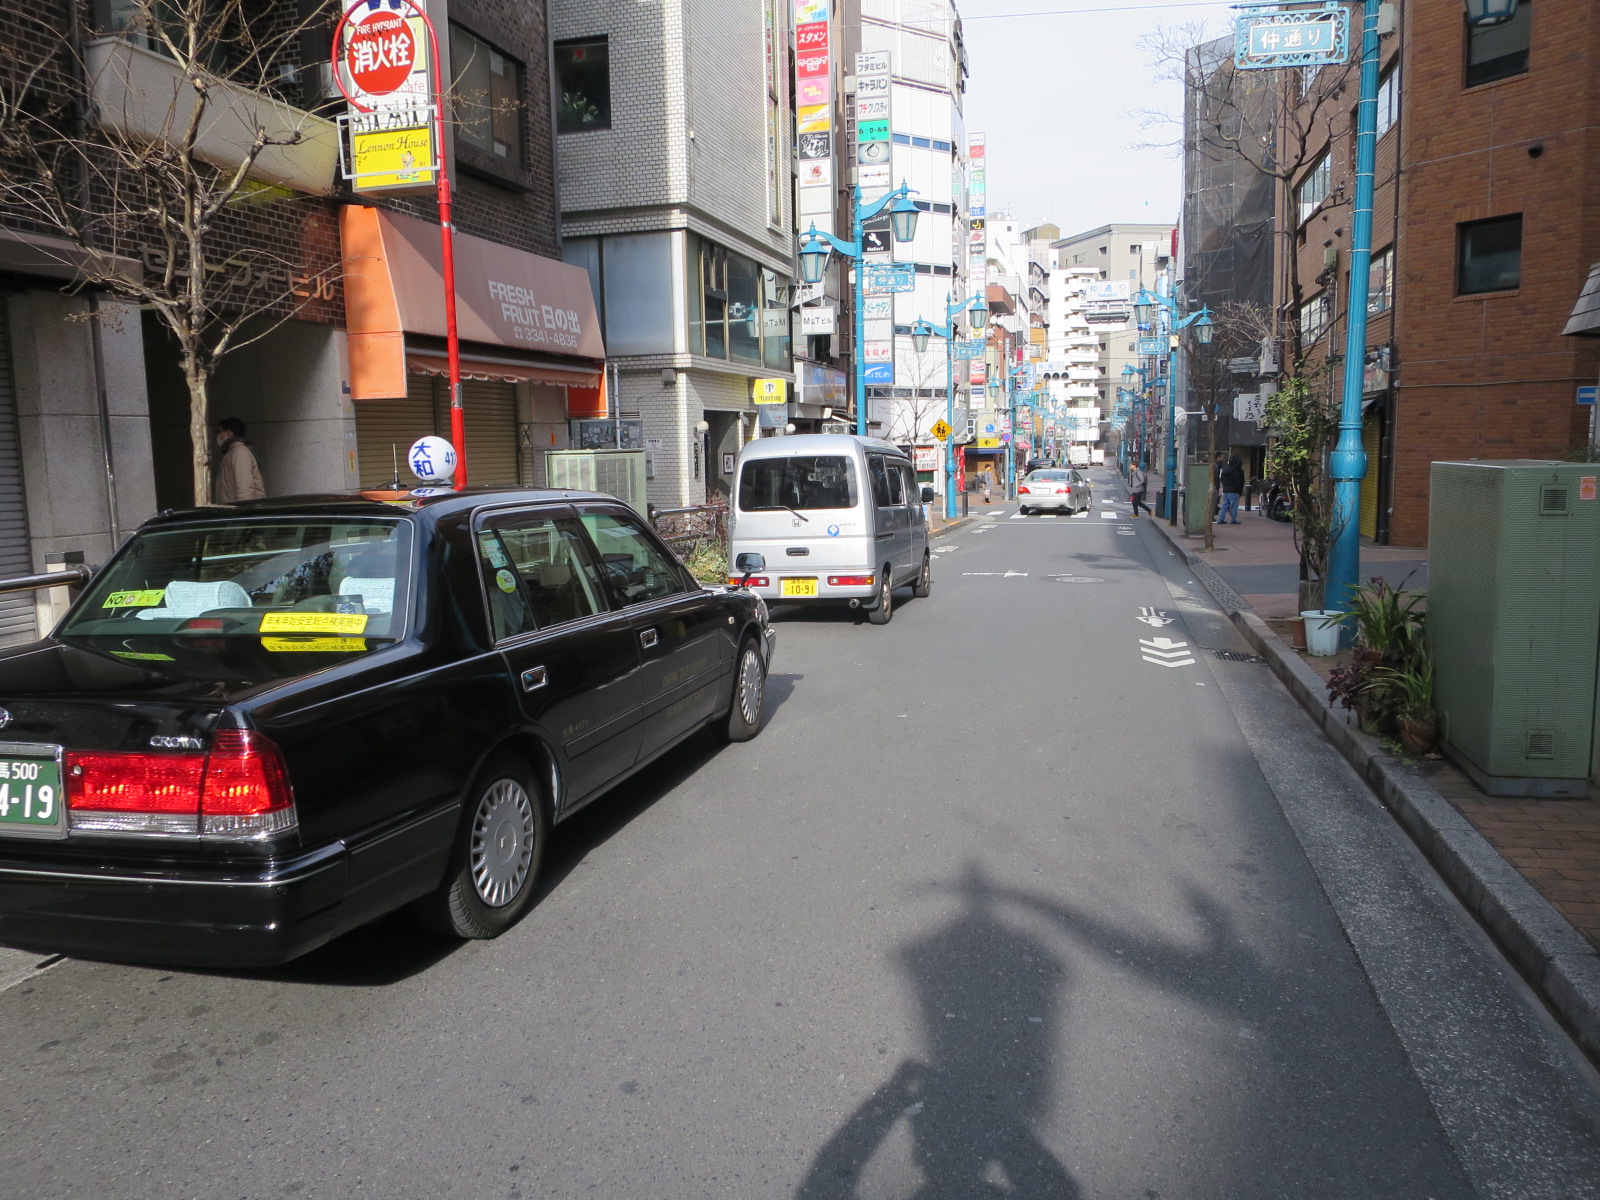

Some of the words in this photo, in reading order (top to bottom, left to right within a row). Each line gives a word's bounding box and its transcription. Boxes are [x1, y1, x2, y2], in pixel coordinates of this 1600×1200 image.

[356, 24, 371, 35] FIRE
[372, 18, 402, 32] HYDRANT
[798, 32, 827, 44] スタメン
[1260, 26, 1321, 50] 仲通り
[352, 33, 411, 74] 消火栓
[858, 62, 887, 72] フタミビル
[858, 79, 887, 92] キャラバン
[357, 140, 394, 154] Lennon
[396, 134, 428, 150] House
[878, 276, 904, 285] 仲通り
[1090, 283, 1126, 292] 仲通り
[488, 280, 536, 307] FRESH
[501, 302, 540, 327] FRUIT
[541, 304, 581, 334] 日の出
[524, 327, 577, 348] 3341-4836
[412, 441, 435, 477] 大和
[790, 584, 814, 595] 10-91
[150, 735, 203, 749] CROWN
